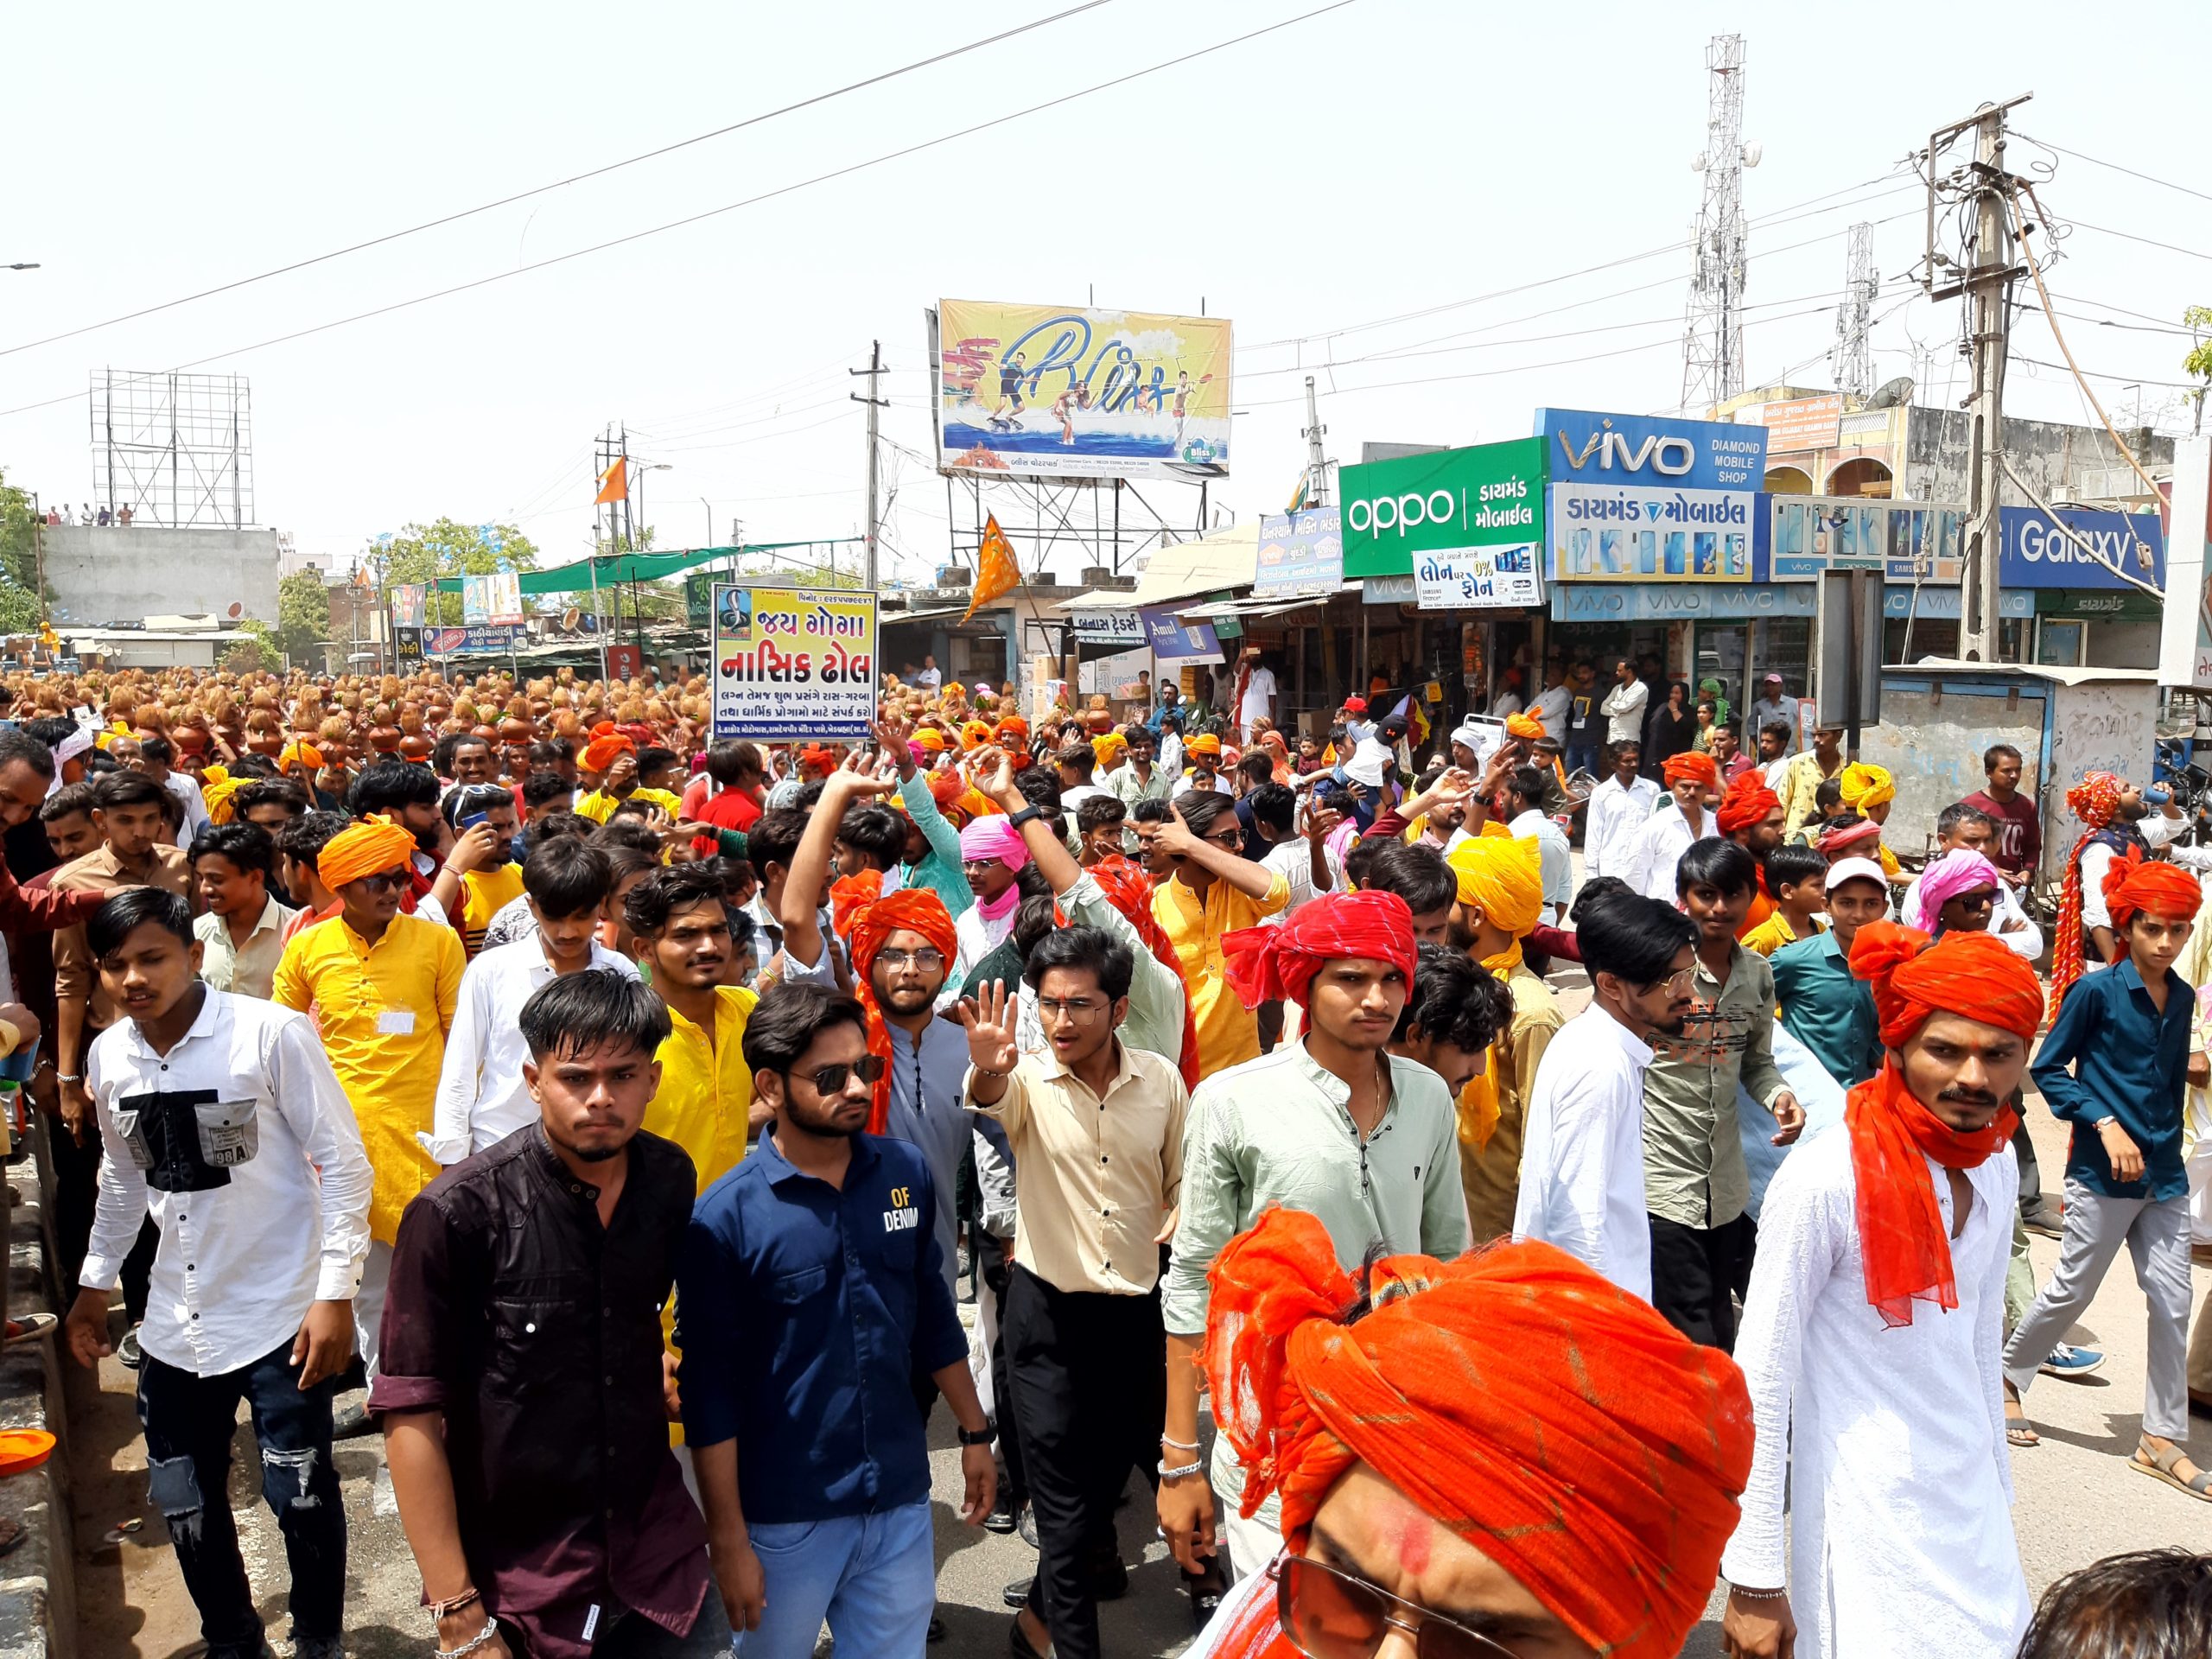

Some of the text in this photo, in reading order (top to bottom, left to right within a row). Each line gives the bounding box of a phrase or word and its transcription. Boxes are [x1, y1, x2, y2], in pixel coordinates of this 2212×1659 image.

[1823, 421, 1837, 429] BANK
[1191, 447, 1210, 457] Bliss
[1558, 418, 1694, 475] vivo
[1712, 439, 1760, 454] DIAMOND
[1714, 455, 1754, 469] MOBILE
[1718, 471, 1747, 484] SHOP
[1479, 475, 1527, 501] ડાયમંડ
[1349, 490, 1454, 539] oppo
[1476, 503, 1532, 528] મોબાઈલ
[1567, 491, 1745, 524] ડાયમંડ મોબાઈલ
[2019, 519, 2131, 570] Galaxy
[1421, 557, 1453, 582] લોન
[1473, 560, 1493, 577] 0%
[1462, 572, 1494, 599] ફોન
[1647, 589, 1700, 609] vivo
[1723, 588, 1774, 608] vivo
[757, 606, 864, 638] જય ગોગા
[1150, 620, 1177, 638] Amul
[721, 639, 870, 683] નાસિક ઢોલ
[721, 688, 870, 703] લગ્ન તેમજ શુભ પ્રસંગે રાસ-ગરબા
[720, 708, 739, 717] તથા
[742, 705, 772, 717] ધાર્મિક
[812, 705, 829, 717] માટે
[832, 705, 855, 717] સંપર્ક
[856, 705, 871, 717] કરો
[216, 1146, 246, 1164] 98 A
[891, 1187, 909, 1208] OF
[883, 1207, 918, 1232] DENIM
